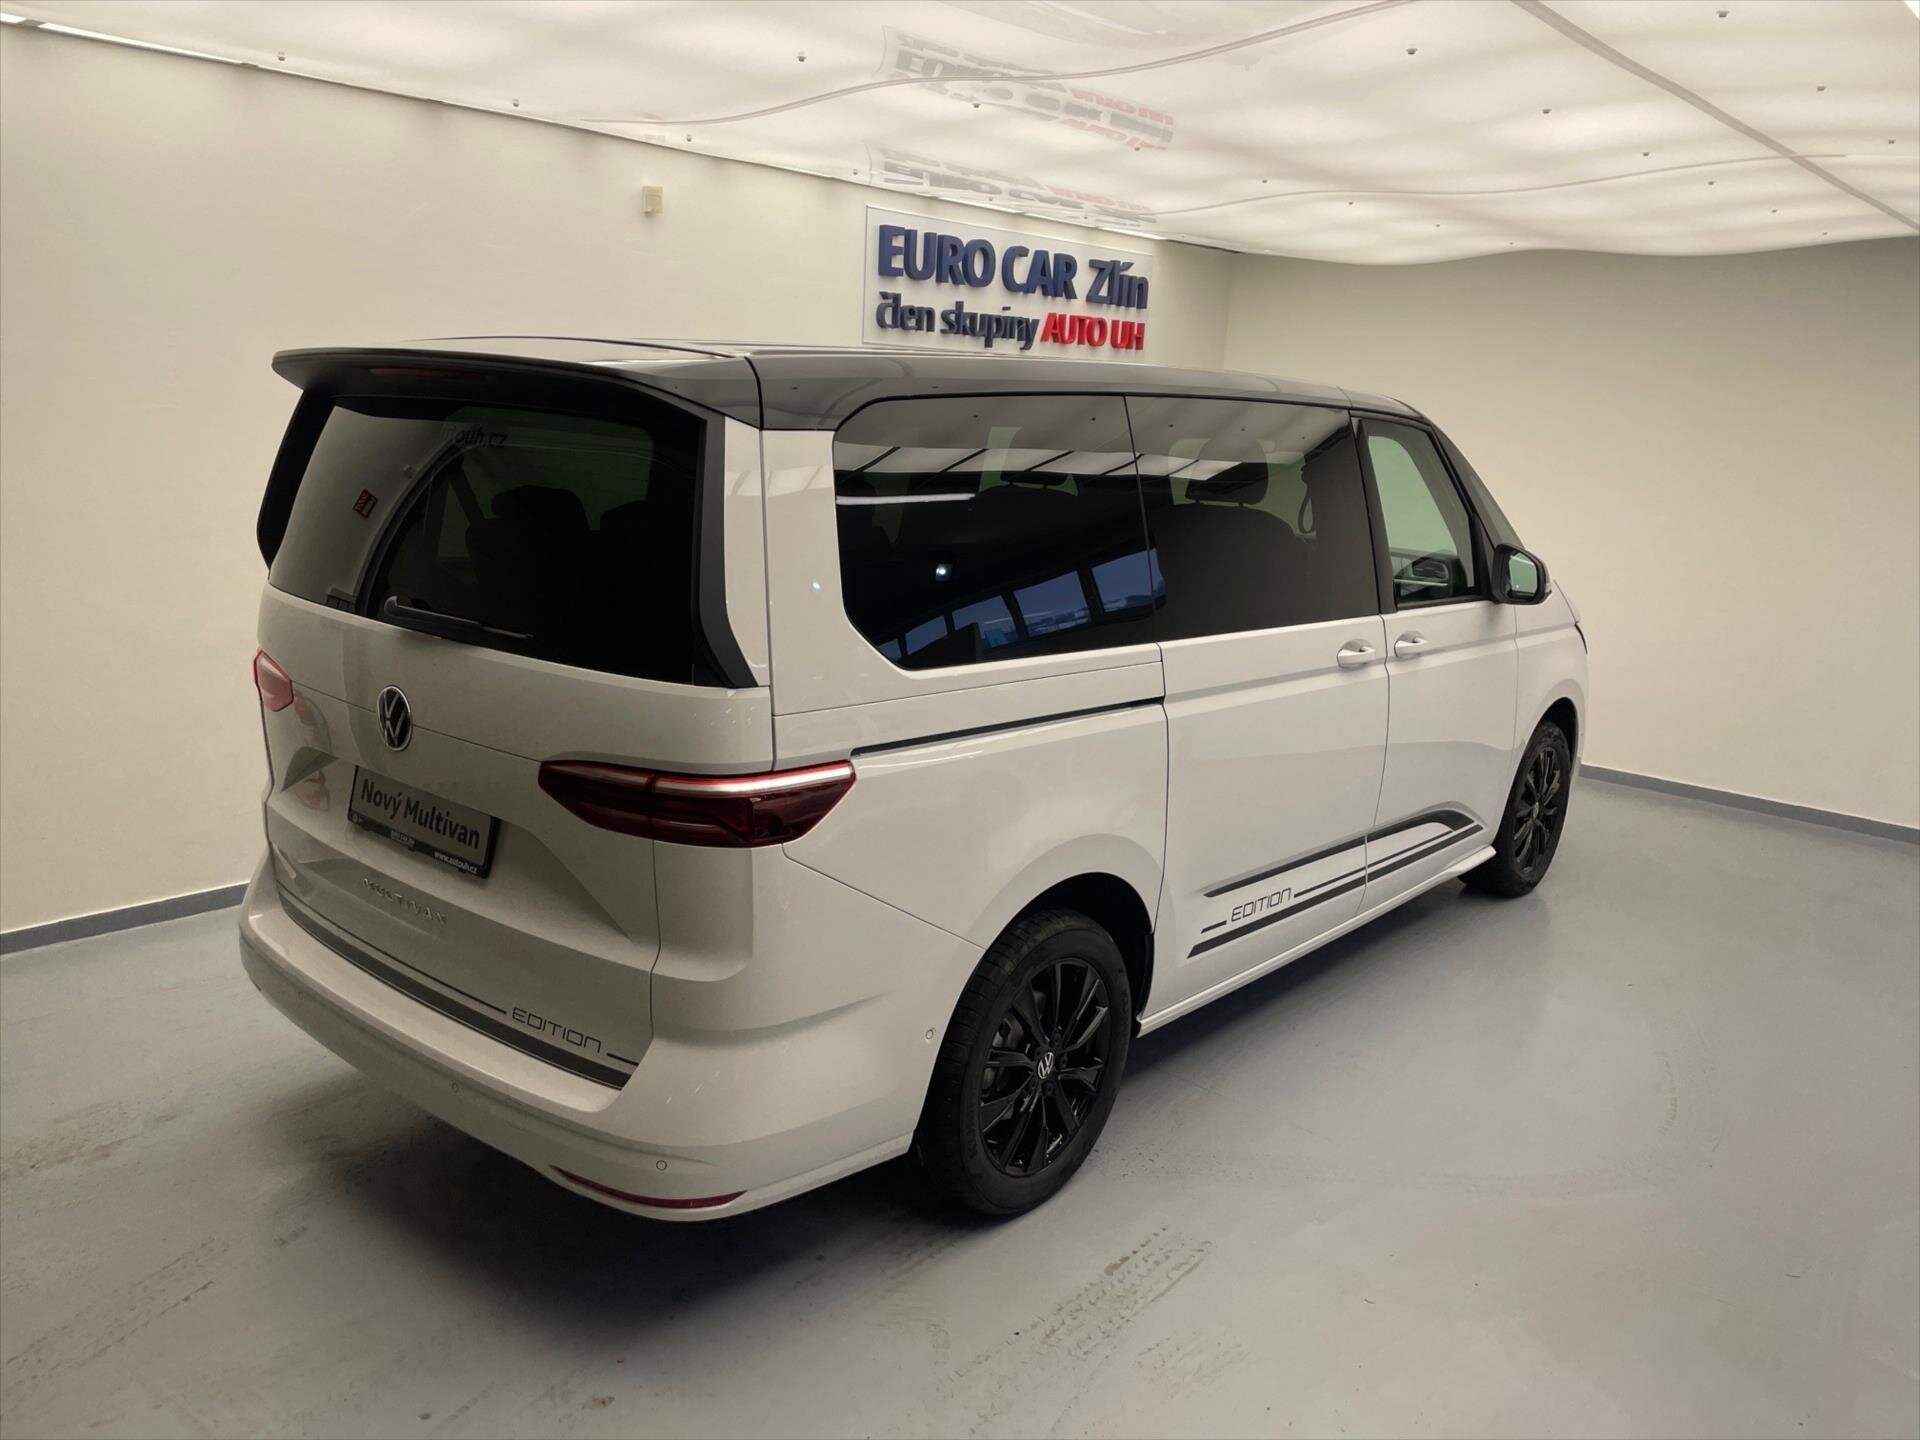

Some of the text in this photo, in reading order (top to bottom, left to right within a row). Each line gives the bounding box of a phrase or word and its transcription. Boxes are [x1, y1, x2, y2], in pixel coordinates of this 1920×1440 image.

[878, 224, 1149, 310] EURO CAR Zlín
[876, 291, 1146, 351] člen skupiny AUTO UH
[361, 778, 480, 849] Nový Multivan
[1231, 887, 1292, 922] EDITION
[512, 1007, 602, 1053] EDITION
